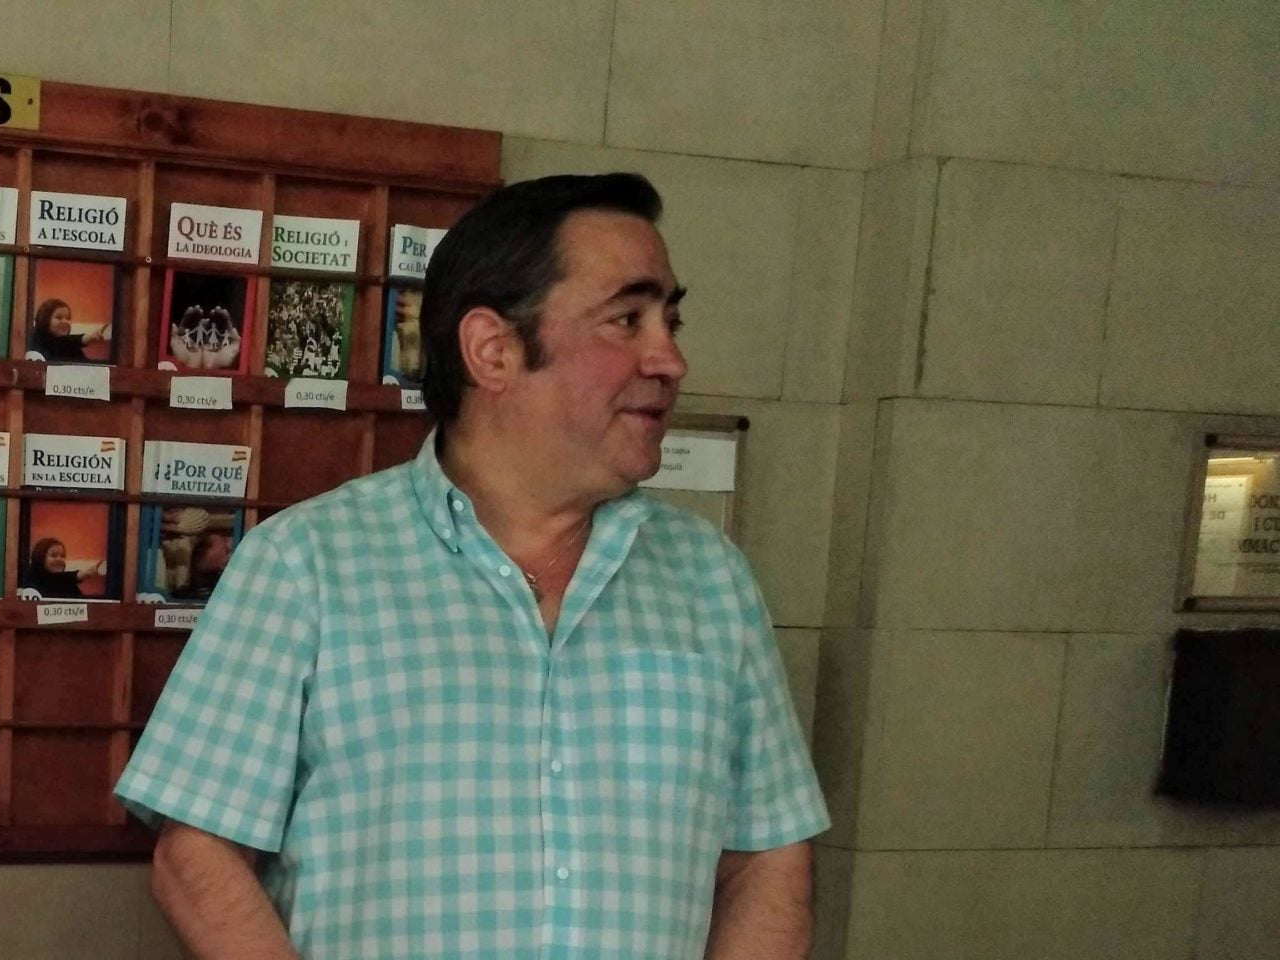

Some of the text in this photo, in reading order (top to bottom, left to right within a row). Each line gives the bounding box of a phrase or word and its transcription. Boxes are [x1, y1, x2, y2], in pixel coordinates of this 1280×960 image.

[38, 199, 120, 226] RELIGIÓ
[37, 227, 47, 239] A
[176, 215, 242, 241] QUÈ ÉS
[273, 226, 341, 247] RELIGIÓ
[176, 242, 252, 259] LA IDEOLOGIA
[272, 246, 351, 267] SOCIETAT
[400, 236, 427, 258] PER
[32, 449, 112, 469] RELIGIÓN
[32, 472, 112, 484] EN LA ESCUELA
[211, 465, 243, 481] QUÉ
[171, 479, 231, 494] BAUTIZAR
